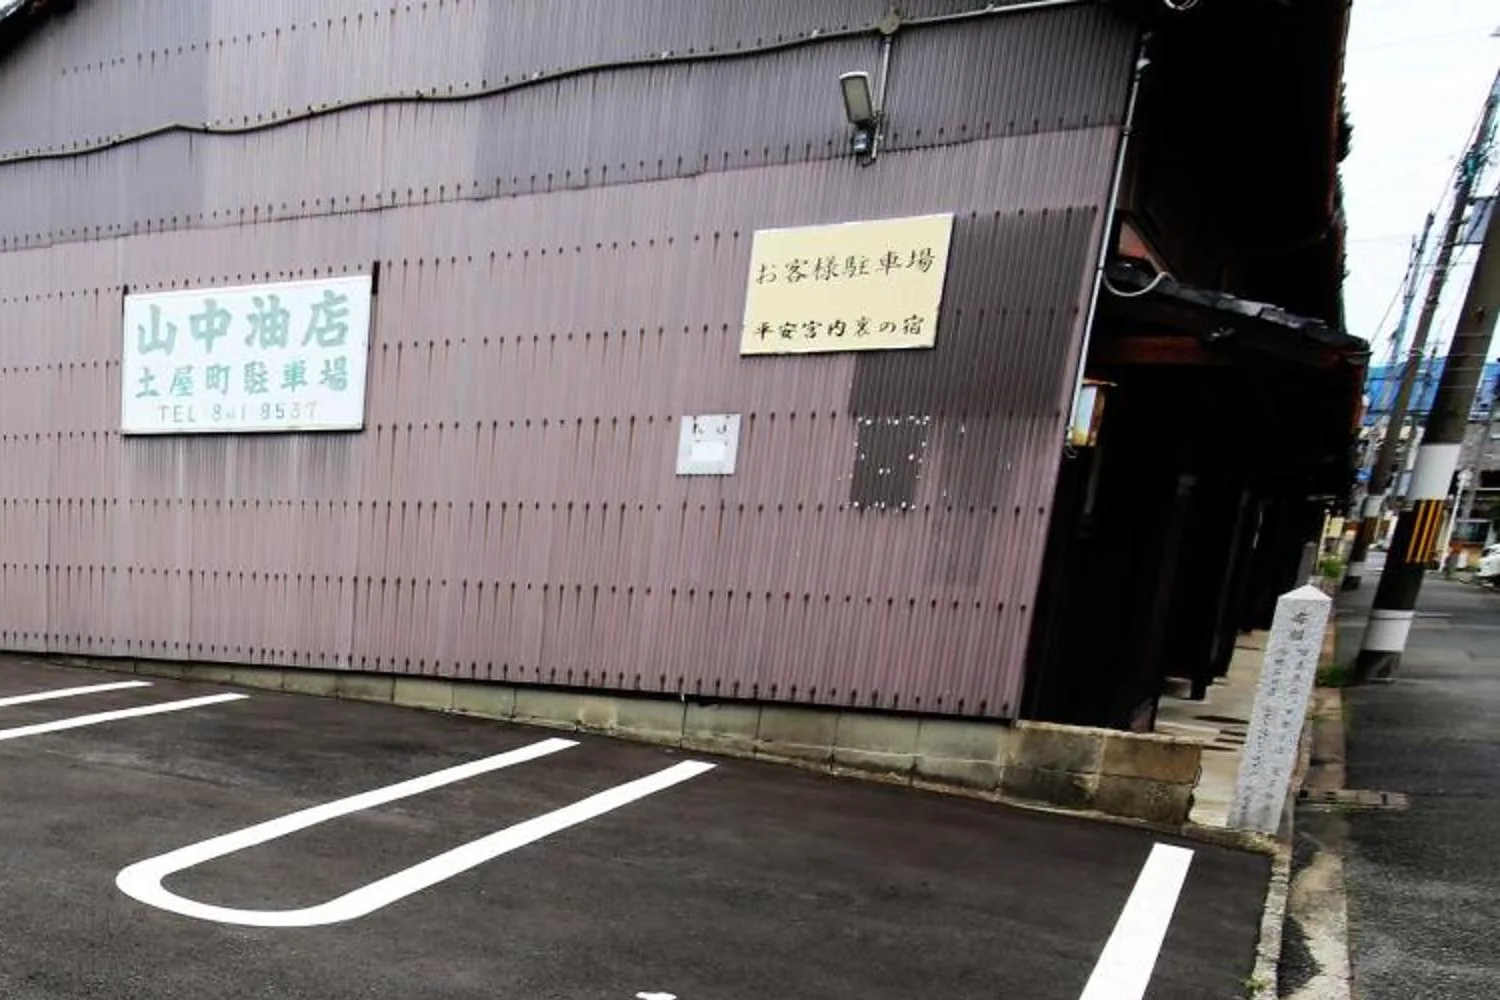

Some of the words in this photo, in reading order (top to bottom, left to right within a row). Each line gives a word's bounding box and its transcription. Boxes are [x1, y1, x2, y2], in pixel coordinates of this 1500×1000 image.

[756, 247, 936, 284] お客様駐車場
[137, 289, 349, 355] 山中油店
[755, 314, 925, 341] 平安宮内裏の宿
[134, 356, 349, 399] 土屋町駐車場
[158, 404, 196, 424] TEL
